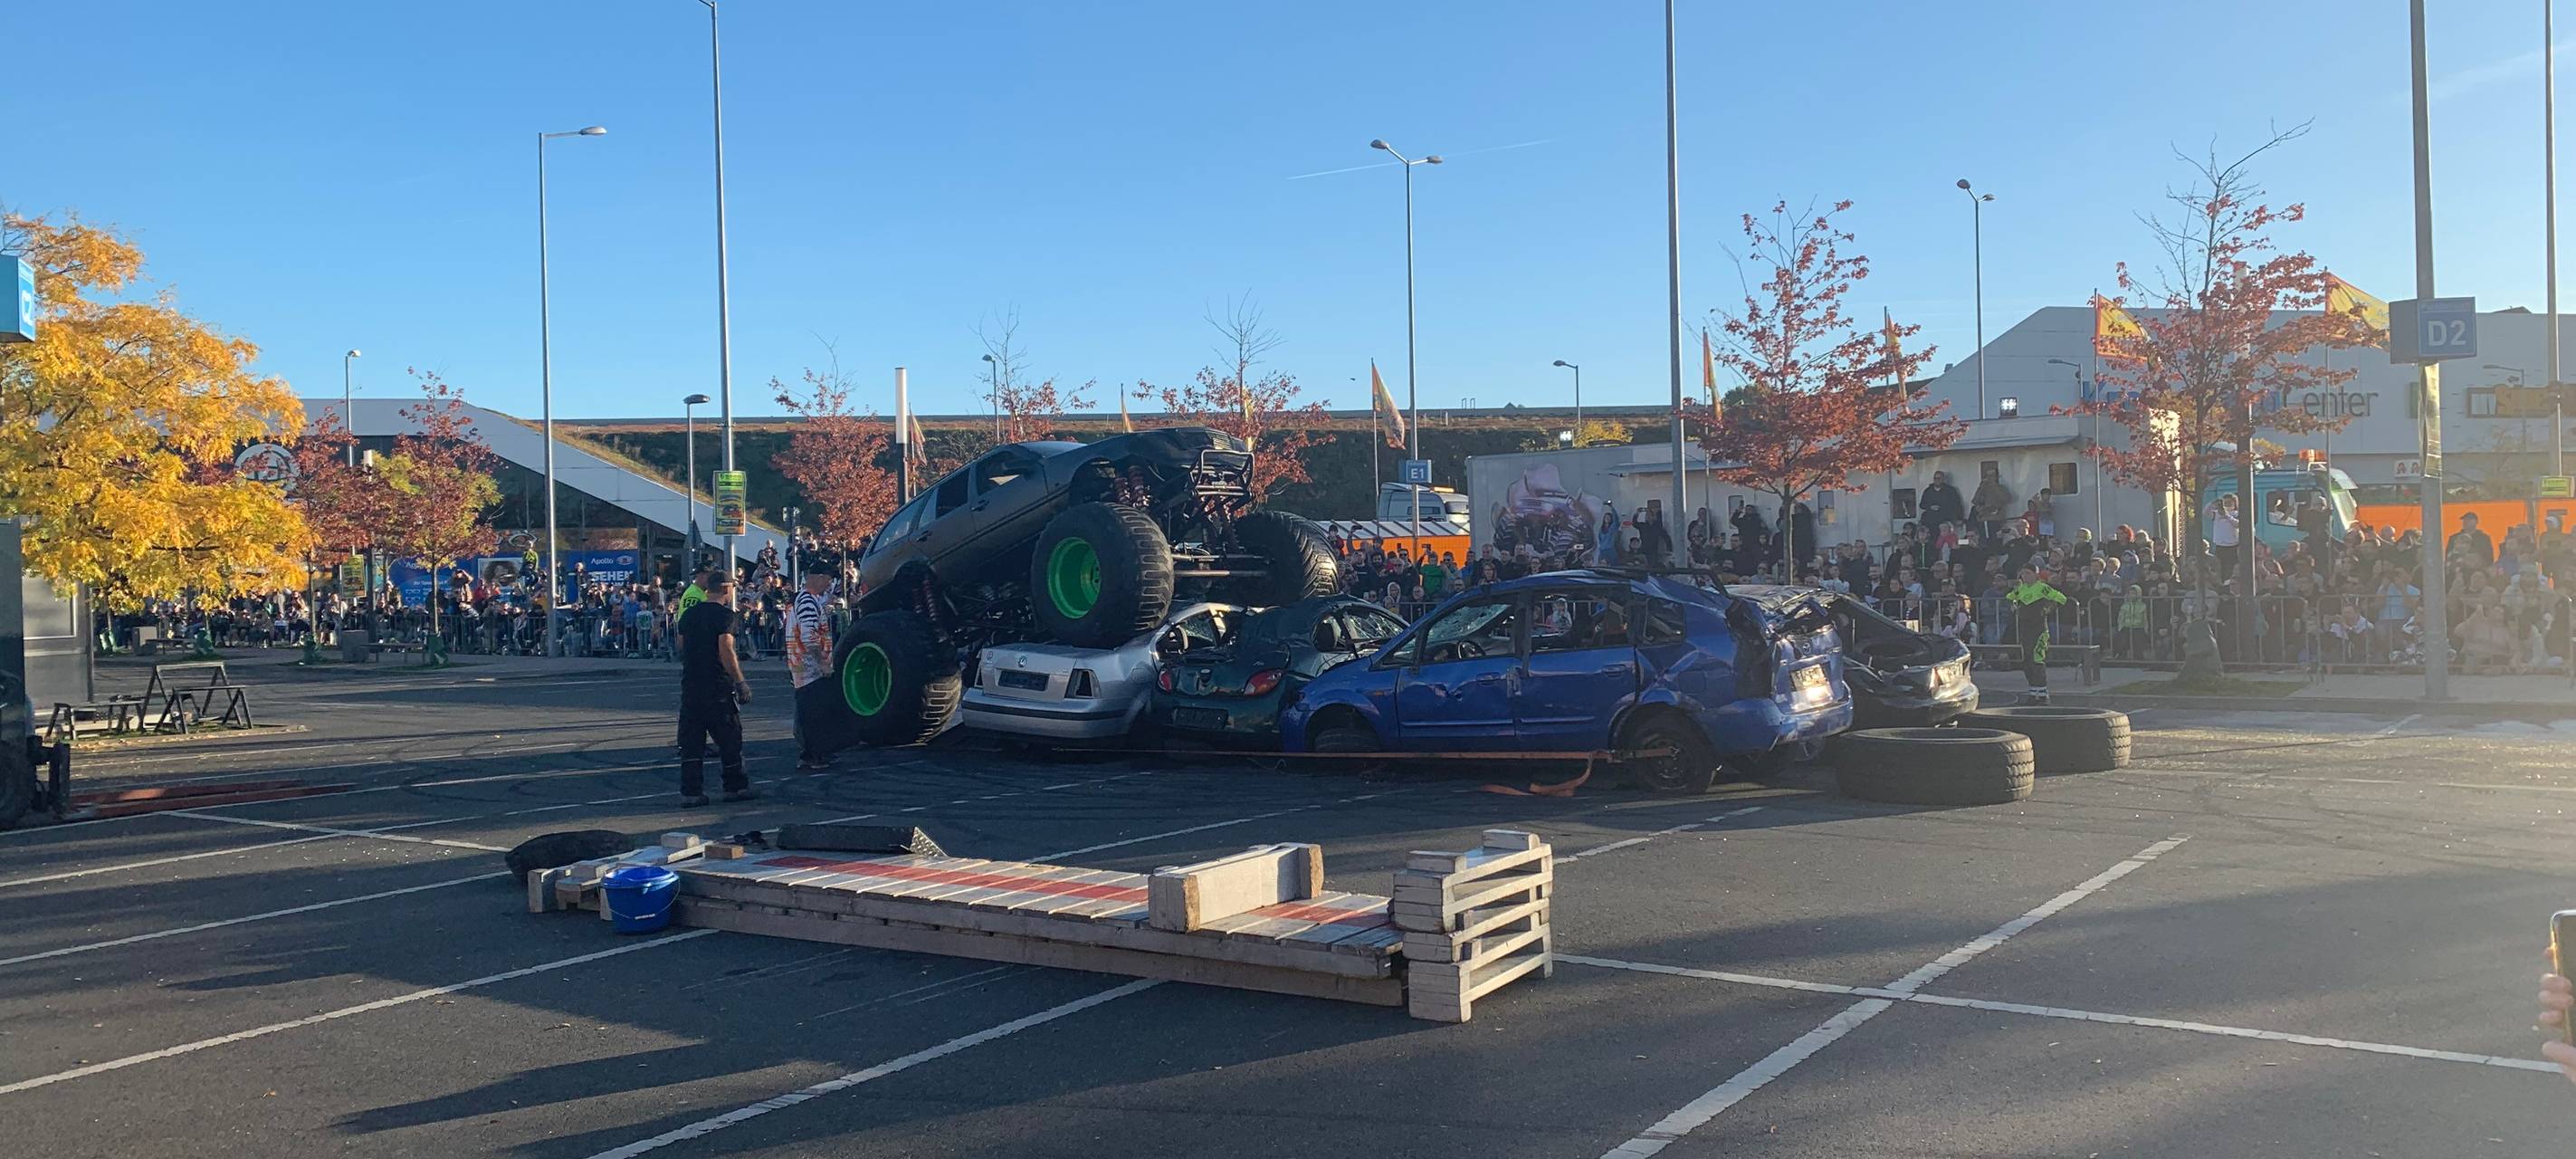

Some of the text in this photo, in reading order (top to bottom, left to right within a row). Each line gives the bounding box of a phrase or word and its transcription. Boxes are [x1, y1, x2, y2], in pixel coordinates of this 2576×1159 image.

[2427, 320, 2466, 346] D2
[2283, 384, 2380, 418] enter
[1411, 468, 1424, 479] E1
[590, 557, 615, 566] Apollo
